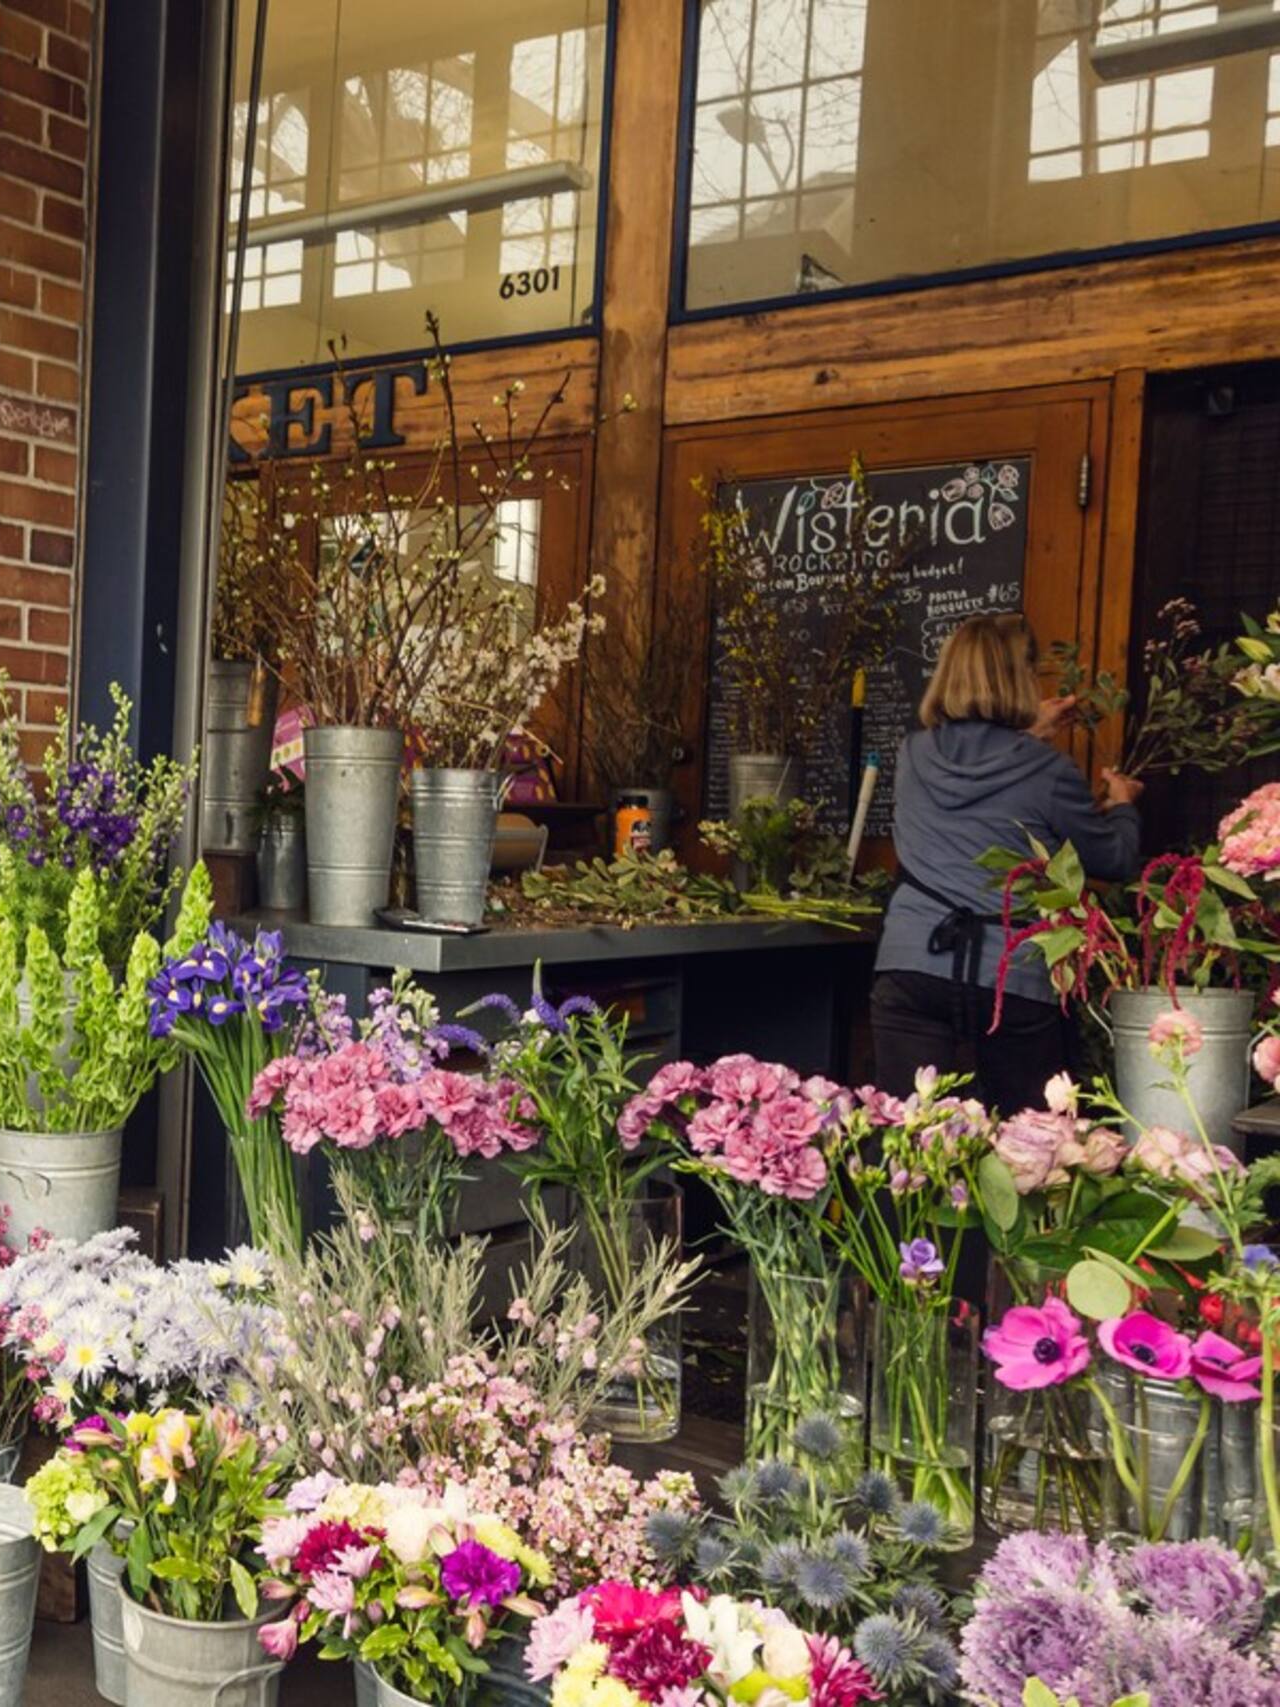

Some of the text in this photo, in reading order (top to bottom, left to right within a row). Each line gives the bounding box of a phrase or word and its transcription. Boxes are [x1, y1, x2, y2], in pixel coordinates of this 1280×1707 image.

[499, 265, 559, 300] 6301
[734, 477, 987, 557] Wisteria
[771, 549, 895, 573] ROCKRIDG
[912, 556, 964, 580] budget!
[987, 581, 1022, 604] $65
